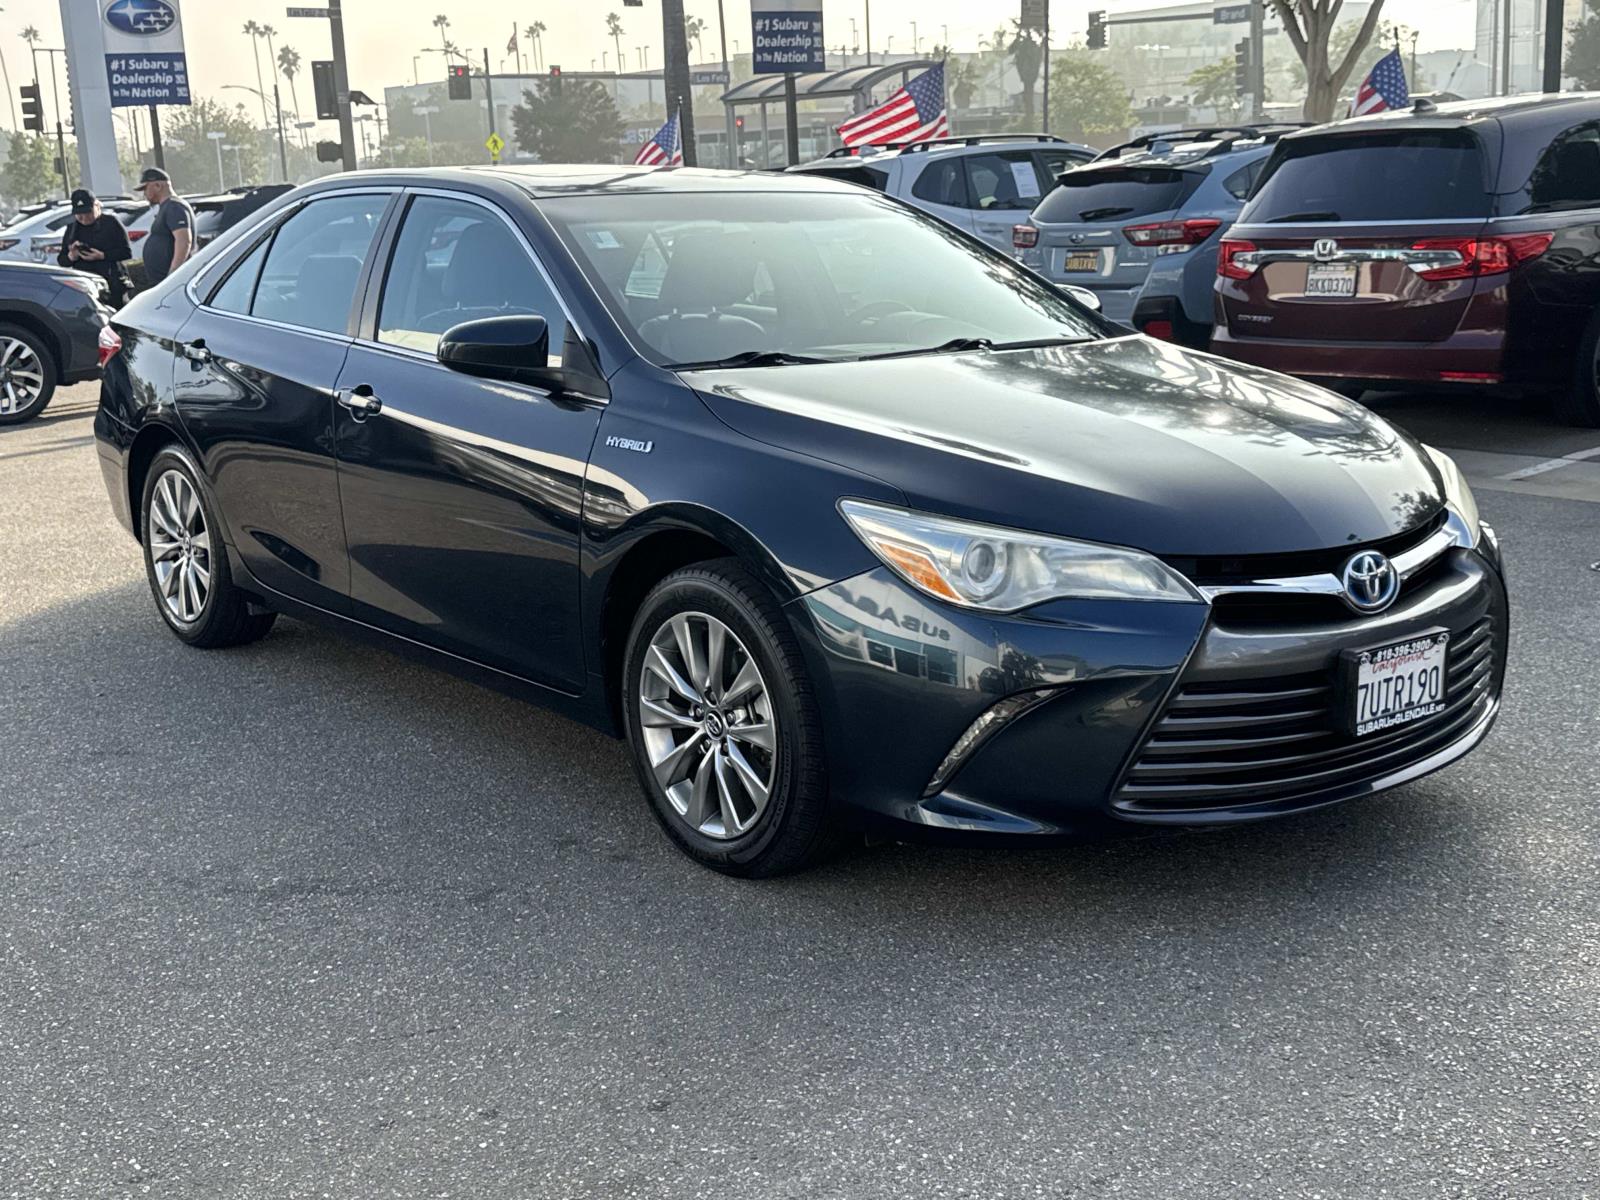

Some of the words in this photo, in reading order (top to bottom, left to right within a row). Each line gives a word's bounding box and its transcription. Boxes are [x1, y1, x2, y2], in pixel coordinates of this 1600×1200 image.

[755, 19, 770, 31] #1
[772, 17, 809, 30] Subaru
[756, 34, 812, 49] Dealership
[773, 51, 808, 63] Nation
[110, 59, 126, 71] #1
[128, 58, 169, 70] Subaru
[112, 73, 173, 85] Dealership
[131, 87, 170, 98] Nation
[606, 436, 646, 452] HYBRID
[1358, 665, 1440, 721] 7UIR190
